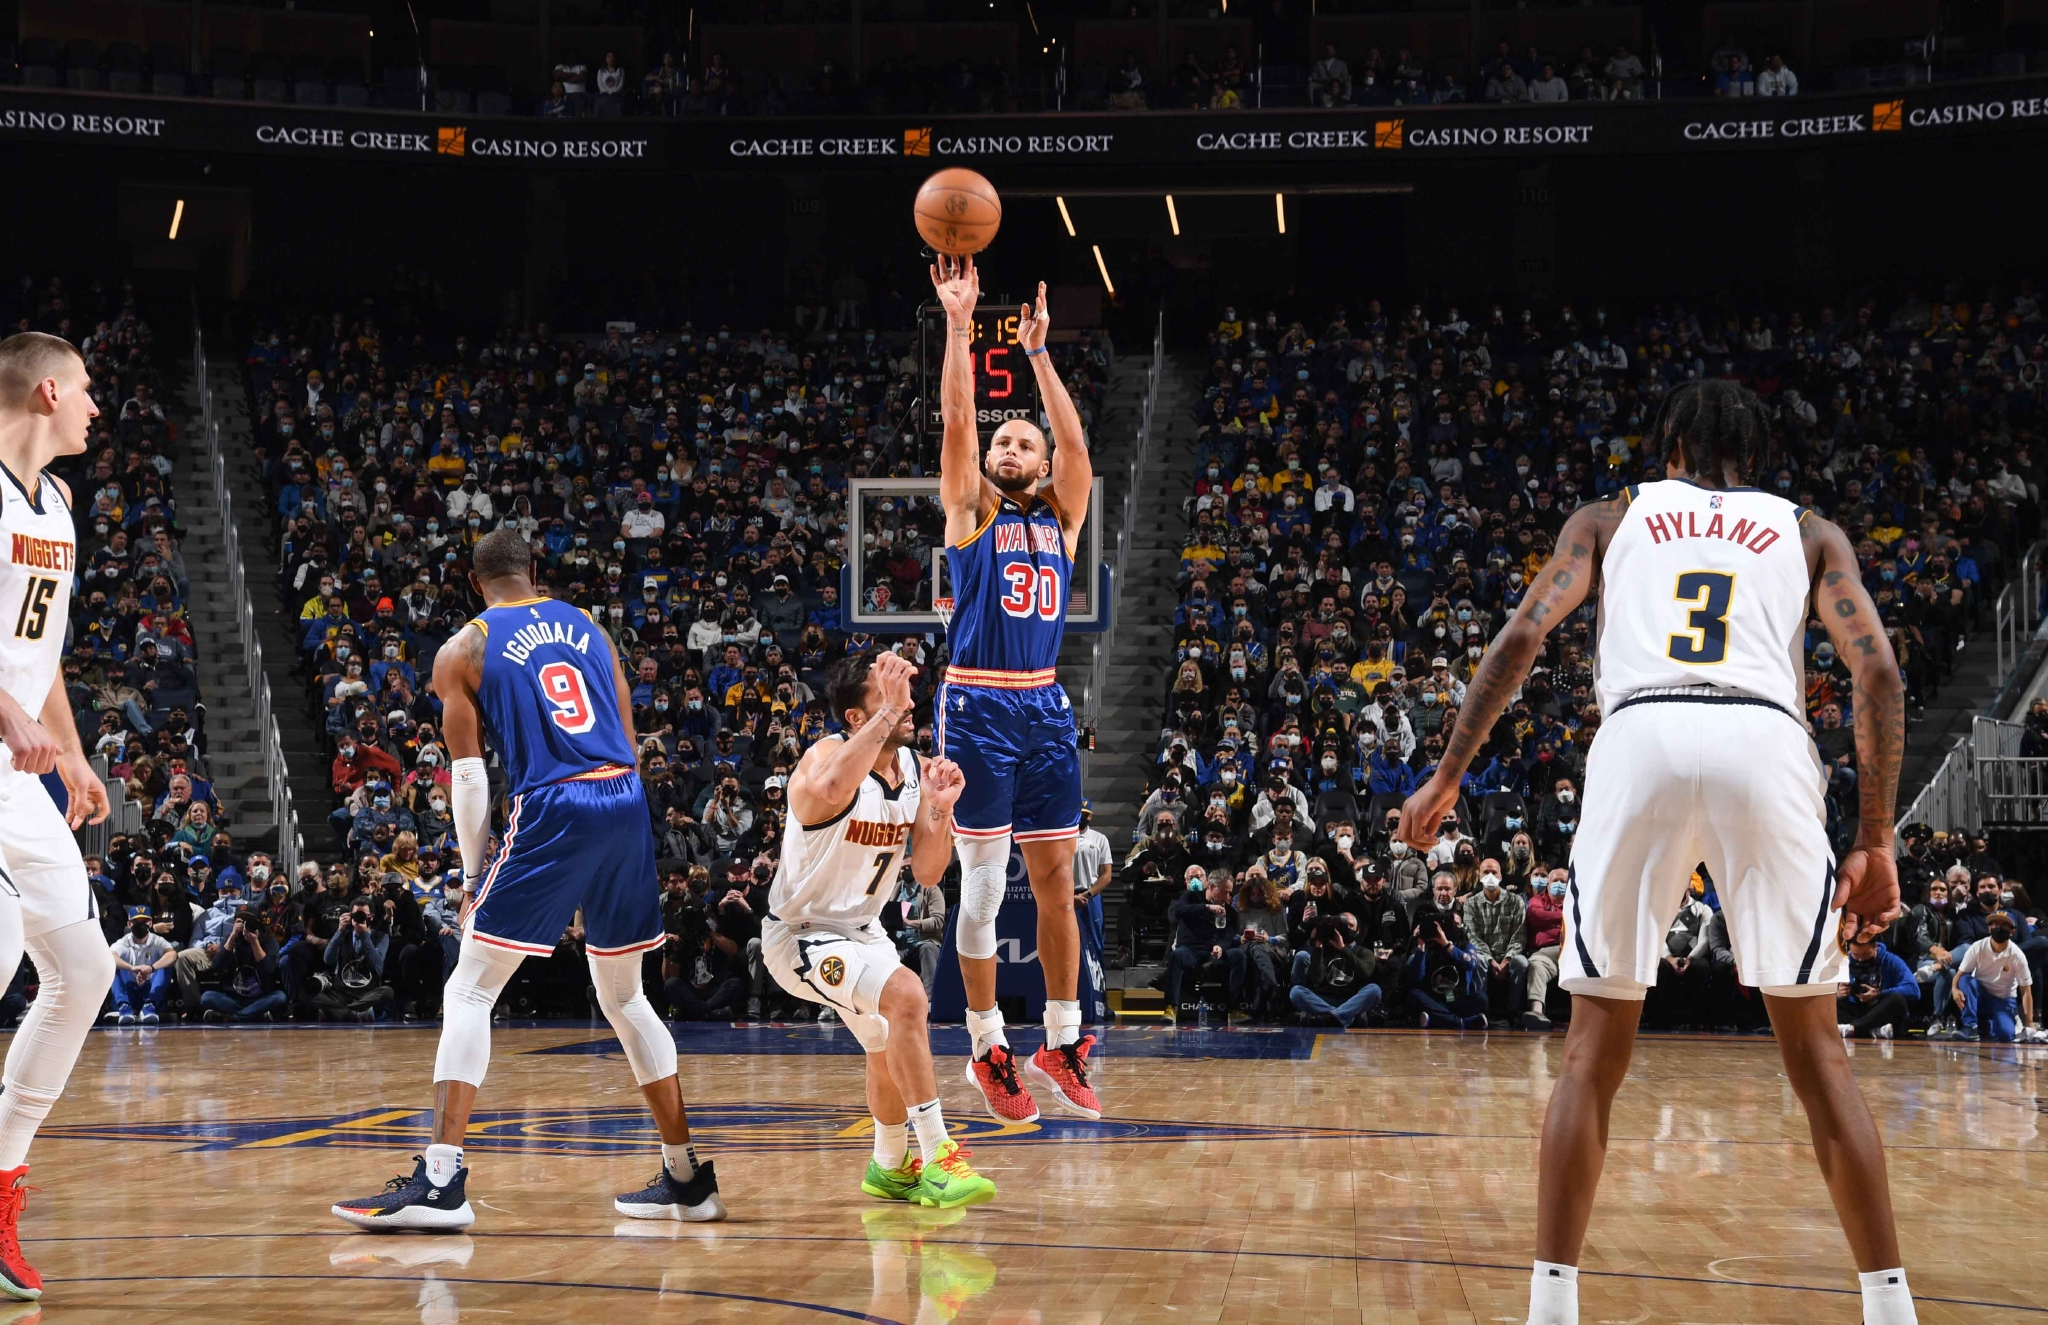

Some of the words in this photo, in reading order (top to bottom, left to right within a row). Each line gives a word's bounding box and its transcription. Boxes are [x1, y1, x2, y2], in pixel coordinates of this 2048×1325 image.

[73, 115, 164, 135] RESORT
[1197, 133, 1281, 149] CACHE
[1289, 131, 1368, 148] CREEK
[1410, 128, 1497, 146] CASINO
[1504, 126, 1592, 144] RESORT
[1684, 121, 1773, 139] CACHE
[1781, 115, 1864, 136] CREEK
[1910, 103, 2004, 126] CASINO
[257, 127, 343, 146] CACHE
[351, 132, 430, 151] CREEK
[472, 139, 557, 157] CASINO
[564, 141, 647, 157] RESORT
[730, 140, 813, 156] CACHE
[820, 139, 897, 155] CREEK
[937, 137, 1021, 154] CASINO
[1028, 135, 1113, 152] RESORT
[977, 408, 1031, 423] SSOT
[11, 533, 74, 572] NUGGETS
[1645, 511, 1780, 555] HYLAND
[14, 574, 60, 642] 15
[1001, 561, 1060, 621] 30
[1666, 569, 1737, 666] 3
[502, 621, 590, 667] IGUODALA
[538, 661, 596, 735] 9
[844, 819, 914, 848] NUGGET
[864, 850, 897, 897] 7
